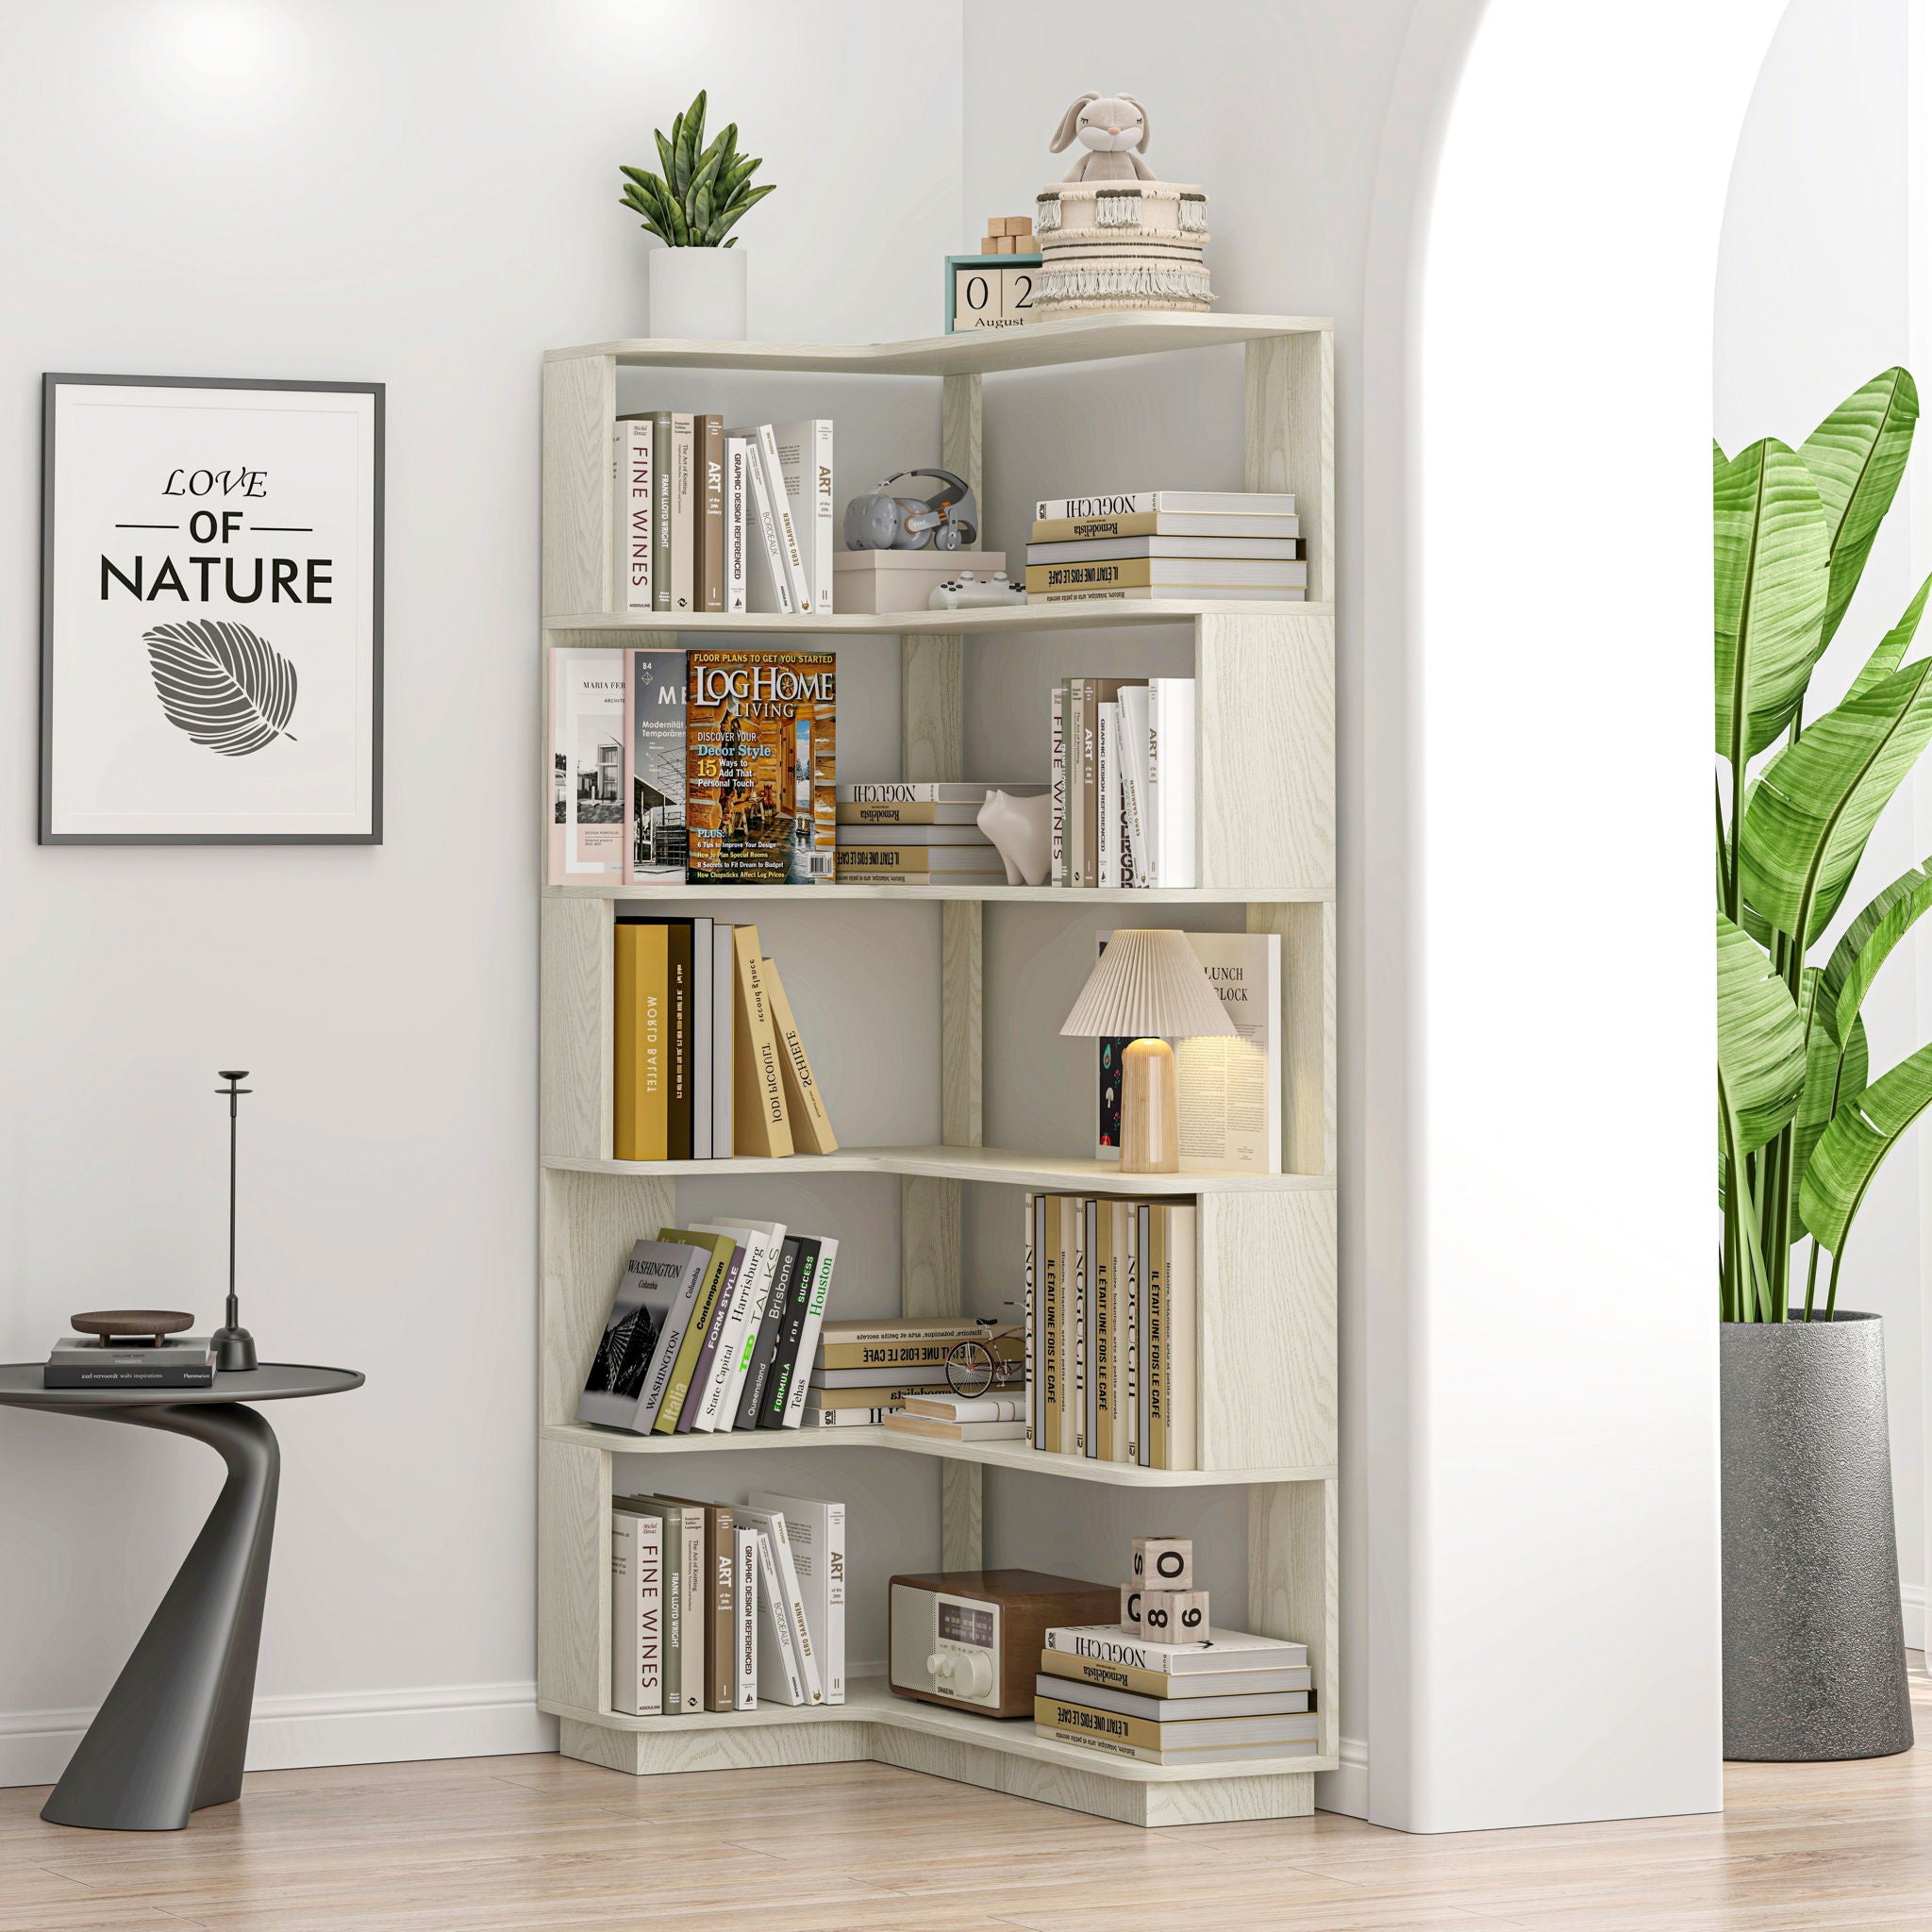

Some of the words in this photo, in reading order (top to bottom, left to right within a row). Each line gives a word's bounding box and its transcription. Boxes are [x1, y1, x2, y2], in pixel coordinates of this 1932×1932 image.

[1014, 275, 1034, 309] 2
[974, 316, 1024, 330] August
[161, 466, 268, 498] LOVE
[633, 447, 648, 498] FINE
[661, 475, 670, 496] FRANK
[708, 461, 721, 492] ART
[819, 466, 831, 496] ART
[661, 498, 670, 519] LLOYD
[1066, 495, 1136, 518] NOGUCHI
[189, 509, 243, 544] OF
[661, 521, 670, 548] WRIGHT
[762, 511, 778, 557] BORDEAUX
[783, 513, 795, 547] SAARINEN
[1074, 523, 1118, 537] Remodelista
[632, 509, 648, 586] WINES
[791, 549, 800, 566] EERO
[101, 554, 332, 605] NATURE
[694, 654, 720, 662] FLOOR
[723, 654, 748, 662] PLANS
[736, 703, 794, 718] LIVING
[698, 732, 734, 741] DISCOVER
[737, 732, 757, 741] YOUR
[698, 745, 735, 757] Decor
[738, 744, 771, 759] Style
[1054, 716, 1062, 769] FINE
[697, 759, 717, 777] 15
[719, 759, 738, 768] Ways
[854, 785, 915, 802] NOGUCHI
[860, 810, 899, 822] Remodelista
[1053, 779, 1062, 859] WINES
[628, 1259, 682, 1279] WASHINGTON
[1048, 1260, 1055, 1269] IL
[1099, 1266, 1107, 1274] IL
[1152, 1271, 1159, 1281] IL
[639, 1280, 658, 1290] Columbia
[769, 1255, 792, 1319] Brisbane
[809, 1257, 832, 1316] Houston
[1099, 1279, 1108, 1309] ÉTAIT
[708, 1311, 724, 1349] FORM
[721, 1266, 739, 1308] STYLE
[740, 1334, 756, 1373] TED
[751, 1247, 779, 1324] TALKS
[1152, 1285, 1160, 1316] ÉTAIT
[646, 1330, 680, 1410] WASHINGTON
[685, 1268, 701, 1299] Columbia
[662, 1383, 688, 1422] Italia
[696, 1261, 724, 1330] Contemporan
[707, 1389, 724, 1415] State
[717, 1345, 734, 1384] Capital
[731, 1247, 765, 1323] Harrisburg
[774, 1363, 791, 1412] FORMULA
[791, 1321, 799, 1342] FOR
[797, 1256, 813, 1303] SUCCESS
[1048, 1359, 1055, 1372] LE
[1099, 1366, 1107, 1379] LE
[1152, 1373, 1159, 1386] LE
[1099, 1383, 1108, 1411] CAFÉ
[1152, 1390, 1160, 1419] CAFÉ
[642, 1545, 658, 1598] FINE
[719, 1557, 731, 1587] ART
[831, 1551, 842, 1582] ART
[641, 1609, 658, 1688] WINES
[1075, 1637, 1146, 1668] NOGUCHI
[1083, 1666, 1128, 1687] Remodelista
